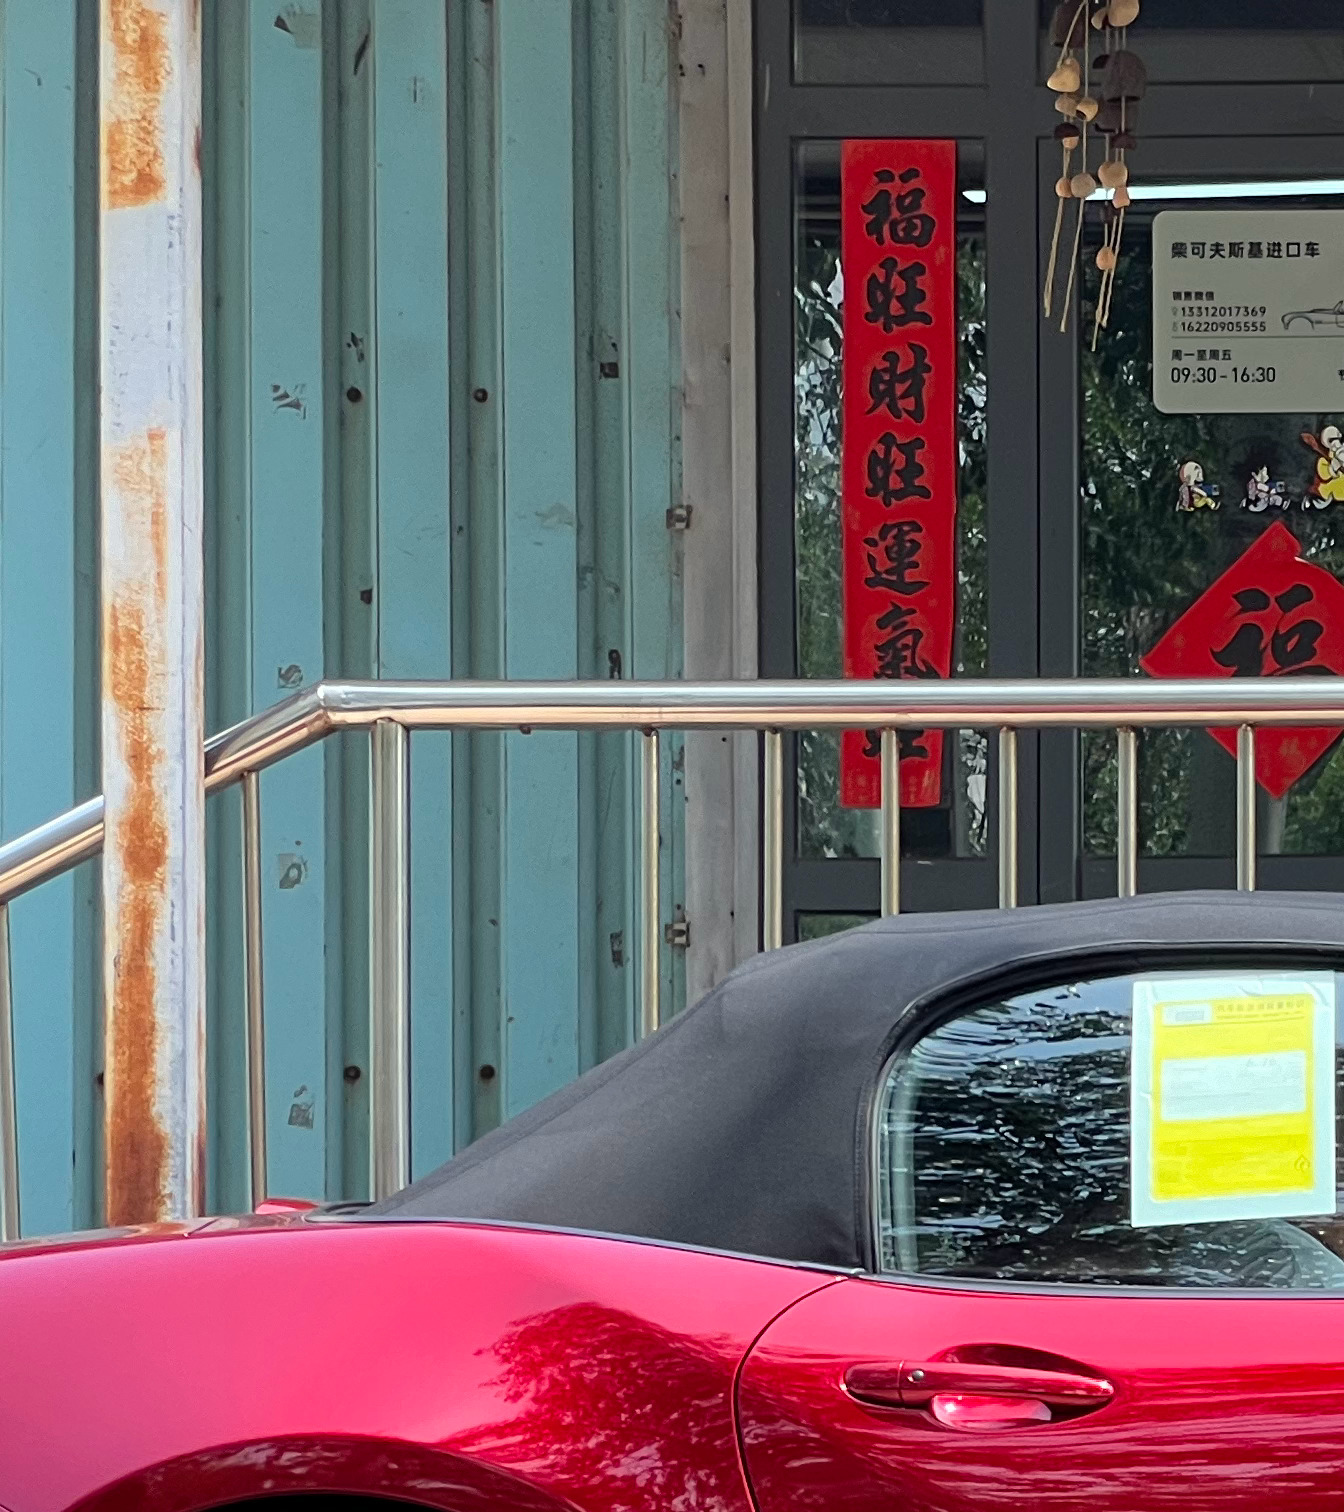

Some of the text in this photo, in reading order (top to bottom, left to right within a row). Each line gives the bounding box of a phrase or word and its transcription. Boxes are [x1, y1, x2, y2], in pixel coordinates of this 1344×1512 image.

[1171, 241, 1321, 259] 柴可夫斯基进口车
[1180, 306, 1267, 317] 13312017369
[1180, 321, 1267, 333] 16220905555
[1171, 349, 1233, 361] 周一至周五
